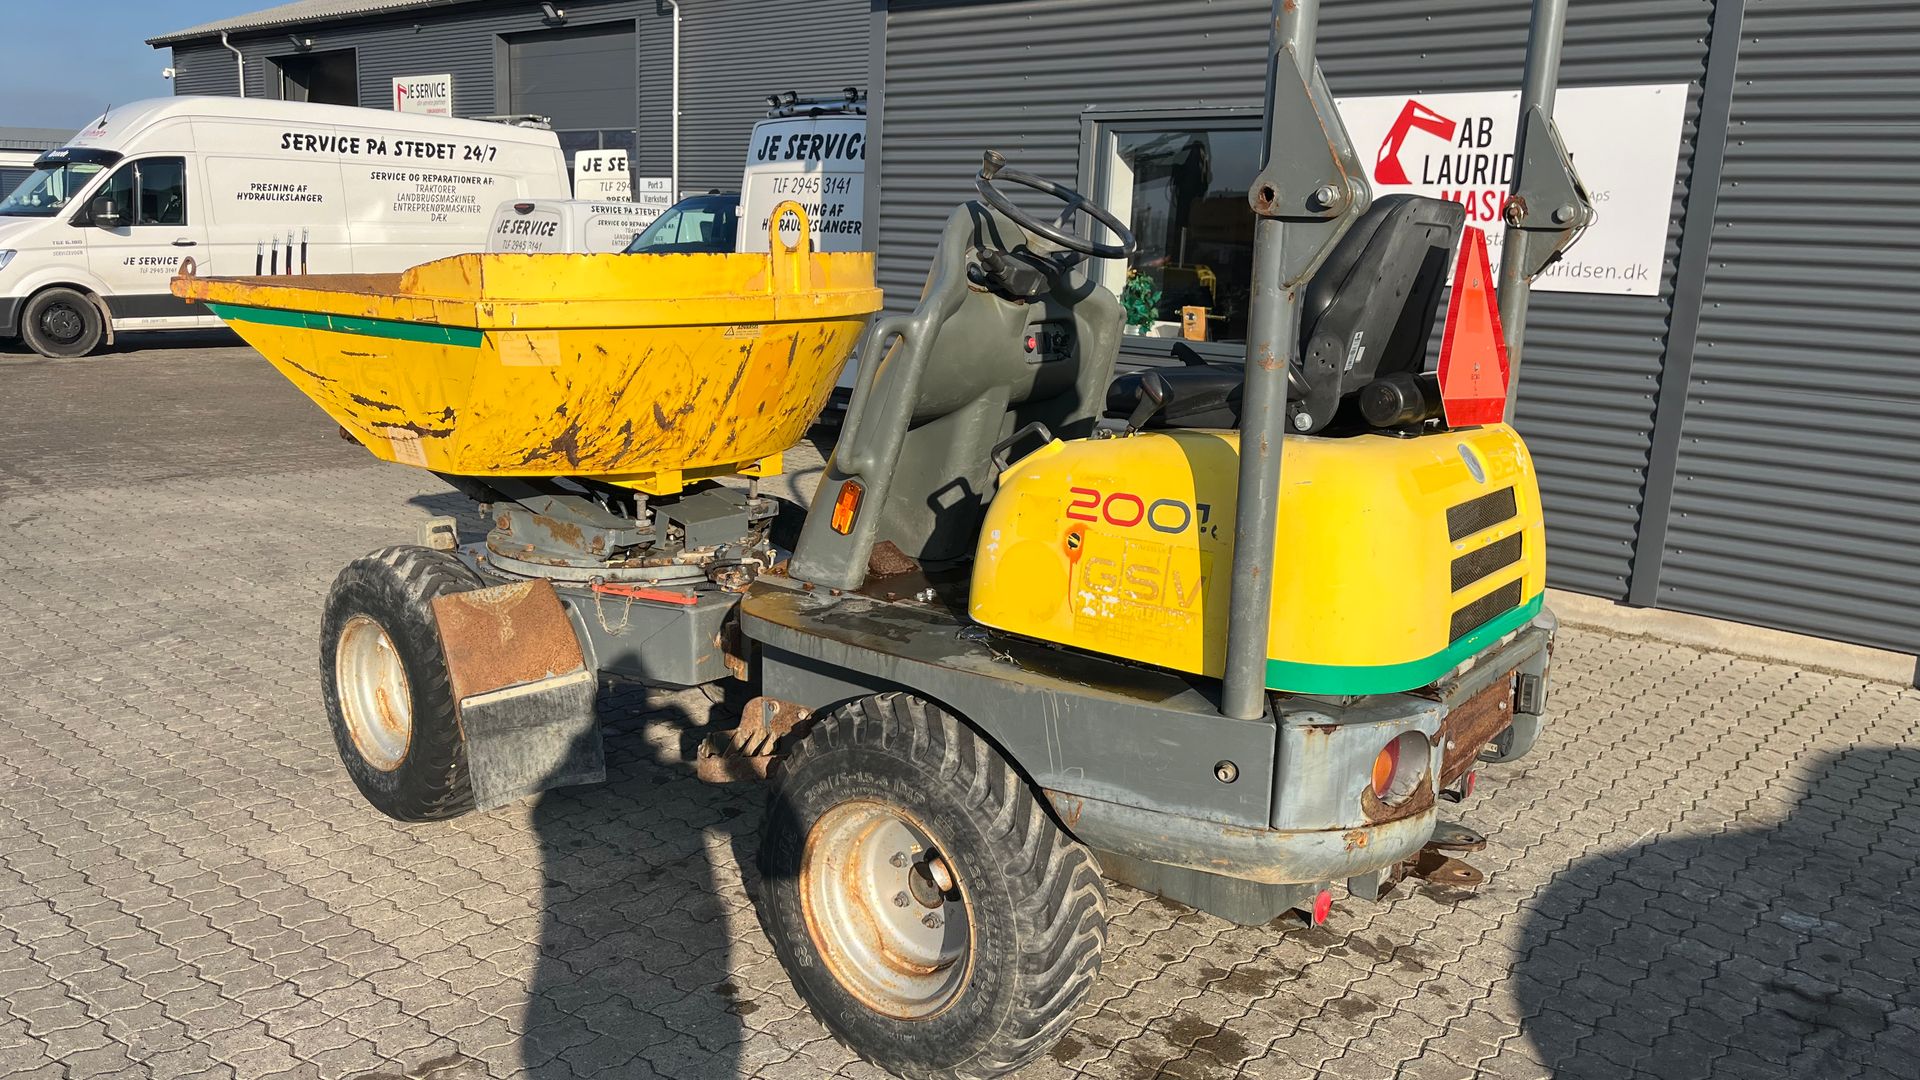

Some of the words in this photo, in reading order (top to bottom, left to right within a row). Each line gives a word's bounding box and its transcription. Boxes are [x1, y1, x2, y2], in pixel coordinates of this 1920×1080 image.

[407, 84, 415, 99] JE
[416, 82, 446, 98] SERVICE
[1458, 116, 1494, 149] AB
[281, 132, 360, 154] SERVICE
[366, 135, 387, 155] PÅ
[394, 140, 457, 159] STEDET
[463, 144, 497, 163] 24/7
[758, 135, 782, 161] JE
[784, 132, 867, 161] SERVIC
[583, 157, 602, 172] JE
[608, 156, 629, 171] SE
[370, 171, 406, 182] SERVICE
[408, 173, 420, 182] OG
[422, 174, 482, 185] REPARATIONER
[483, 176, 495, 186] AF:
[250, 182, 295, 193] PRESNING
[297, 185, 308, 193] AF
[415, 184, 457, 194] TRAKTORER
[600, 181, 614, 192] TLF
[648, 181, 659, 190] Port
[773, 177, 789, 194] TLF
[791, 177, 820, 195] 2945
[823, 176, 852, 195] 3141
[237, 192, 323, 203] HYDRAULIKSLANGER
[397, 193, 476, 204] LANDBRUGSMASKINER
[393, 202, 481, 214] ENTREPRENØRMASKINER
[591, 205, 622, 214] SERVICE
[635, 207, 661, 217] STEDET
[829, 204, 844, 218] AF
[431, 213, 448, 222] DÆK
[497, 219, 511, 234] JE
[510, 220, 558, 237] SERVICE
[511, 239, 527, 251] 2945
[123, 257, 135, 266] JE
[138, 256, 179, 266] SERVICE
